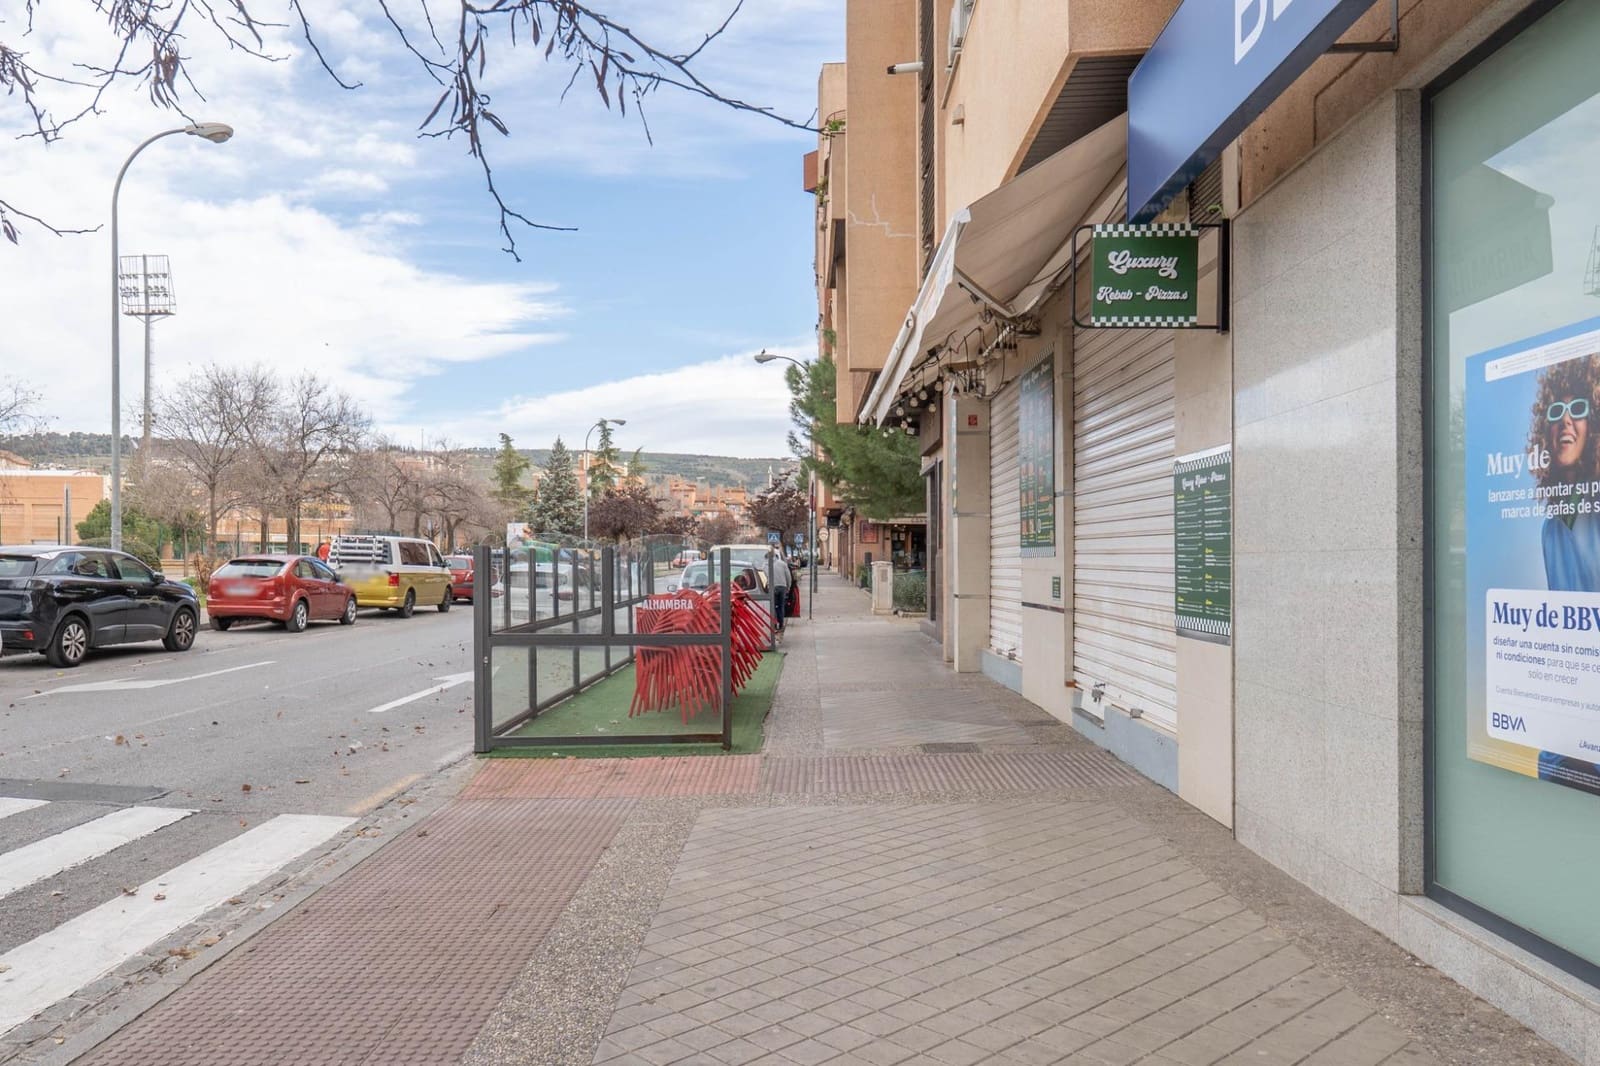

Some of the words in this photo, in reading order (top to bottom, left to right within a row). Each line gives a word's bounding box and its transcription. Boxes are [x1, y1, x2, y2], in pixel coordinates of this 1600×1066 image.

[1107, 250, 1178, 279] Luxury
[1096, 286, 1133, 304] Kebab
[1486, 452, 1525, 479] Muy
[1527, 444, 1551, 470] de
[1488, 488, 1526, 503] lanzarse
[1528, 488, 1534, 499] a
[1536, 481, 1574, 498] montar
[1575, 482, 1589, 495] su
[1501, 507, 1530, 519] marca
[1532, 503, 1546, 517] de
[1546, 500, 1576, 519] gafas
[1577, 499, 1591, 514] de
[642, 599, 694, 610] ALHAMBRA
[1492, 601, 1532, 632] Muy
[1535, 602, 1559, 628] de
[1493, 636, 1518, 648] diseñar
[1519, 640, 1533, 649] una
[1534, 641, 1560, 652] cuenta
[1561, 643, 1573, 654] sin
[1575, 646, 1600, 657] comis
[1496, 650, 1503, 660] ni
[1503, 652, 1546, 666] condiciones
[1547, 657, 1564, 669] para
[1565, 660, 1579, 673] que
[1580, 663, 1591, 672] se
[1544, 672, 1554, 681] en
[1554, 674, 1578, 685] crecer
[1492, 712, 1527, 733] BBVA
